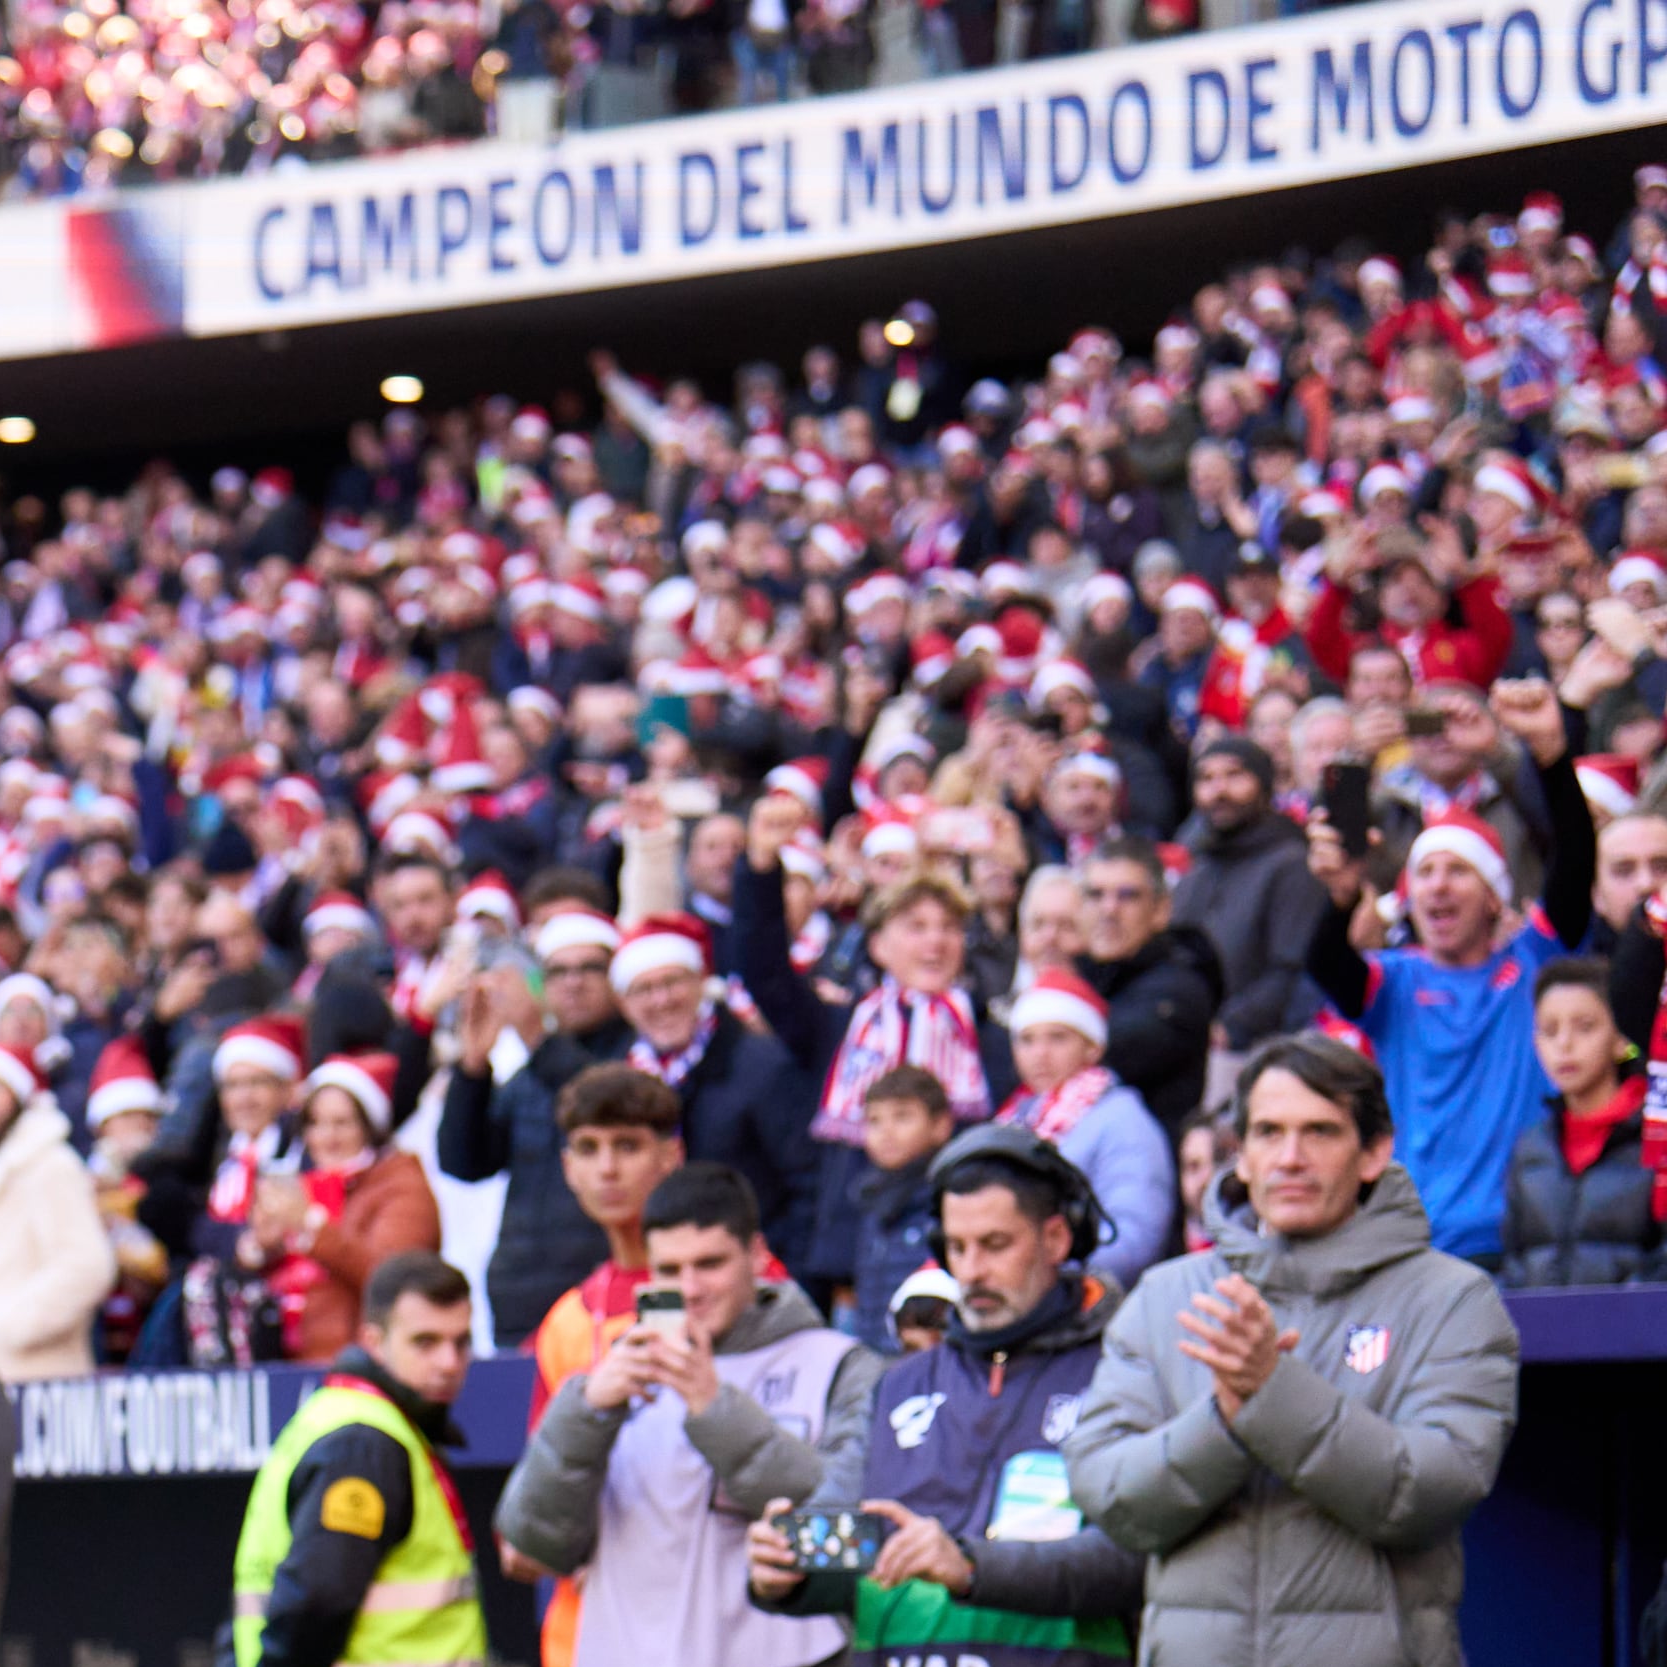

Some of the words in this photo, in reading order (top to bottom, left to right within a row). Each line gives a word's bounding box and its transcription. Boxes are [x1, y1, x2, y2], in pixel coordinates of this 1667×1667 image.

[675, 142, 809, 249] DEL
[837, 100, 1155, 225] MUNDO
[1185, 58, 1282, 173] DE
[1311, 8, 1548, 154] MOTO
[1575, 0, 1667, 106] GP
